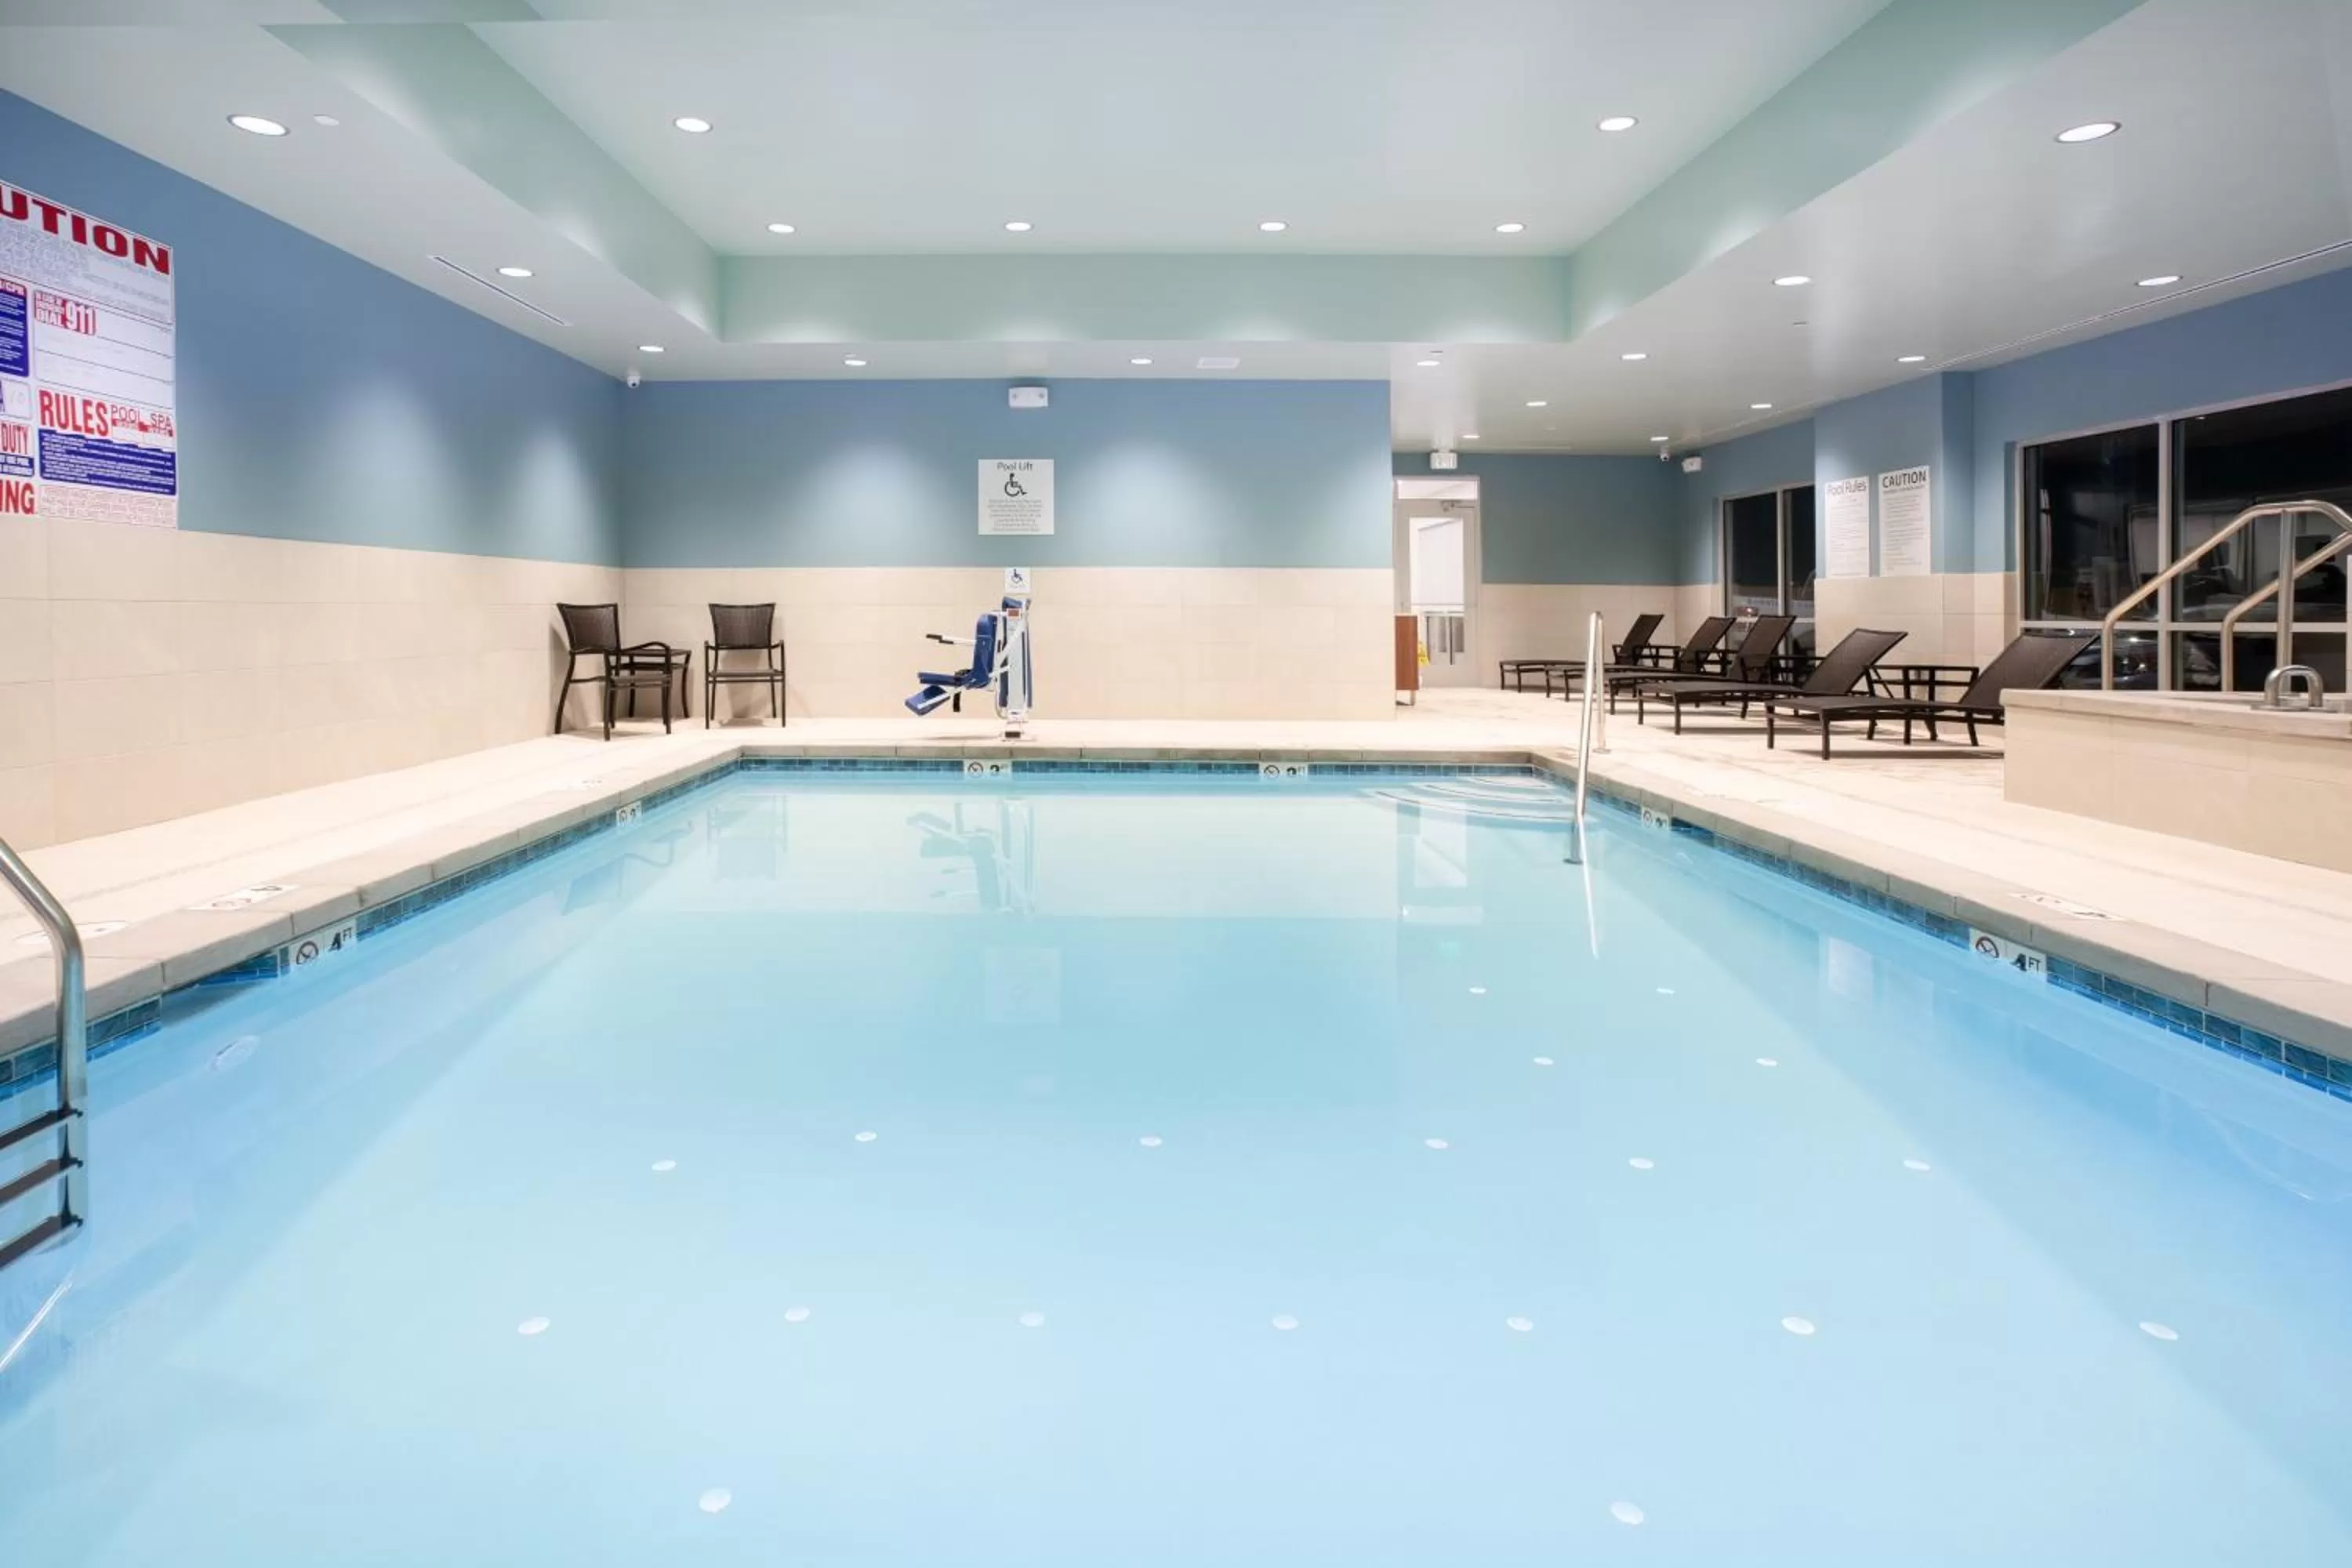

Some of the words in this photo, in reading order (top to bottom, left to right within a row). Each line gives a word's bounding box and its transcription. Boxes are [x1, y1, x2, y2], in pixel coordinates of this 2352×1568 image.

[66, 301, 93, 335] 911
[39, 390, 109, 436] RULES
[150, 413, 172, 431] SPA
[997, 461, 1017, 471] Pool
[1019, 461, 1033, 471] Lift
[1846, 479, 1867, 493] Rules
[1882, 470, 1926, 488] CAUTION
[328, 932, 342, 952] 4
[343, 927, 353, 942] FT
[2010, 953, 2027, 972] 4
[2028, 956, 2041, 972] FT
